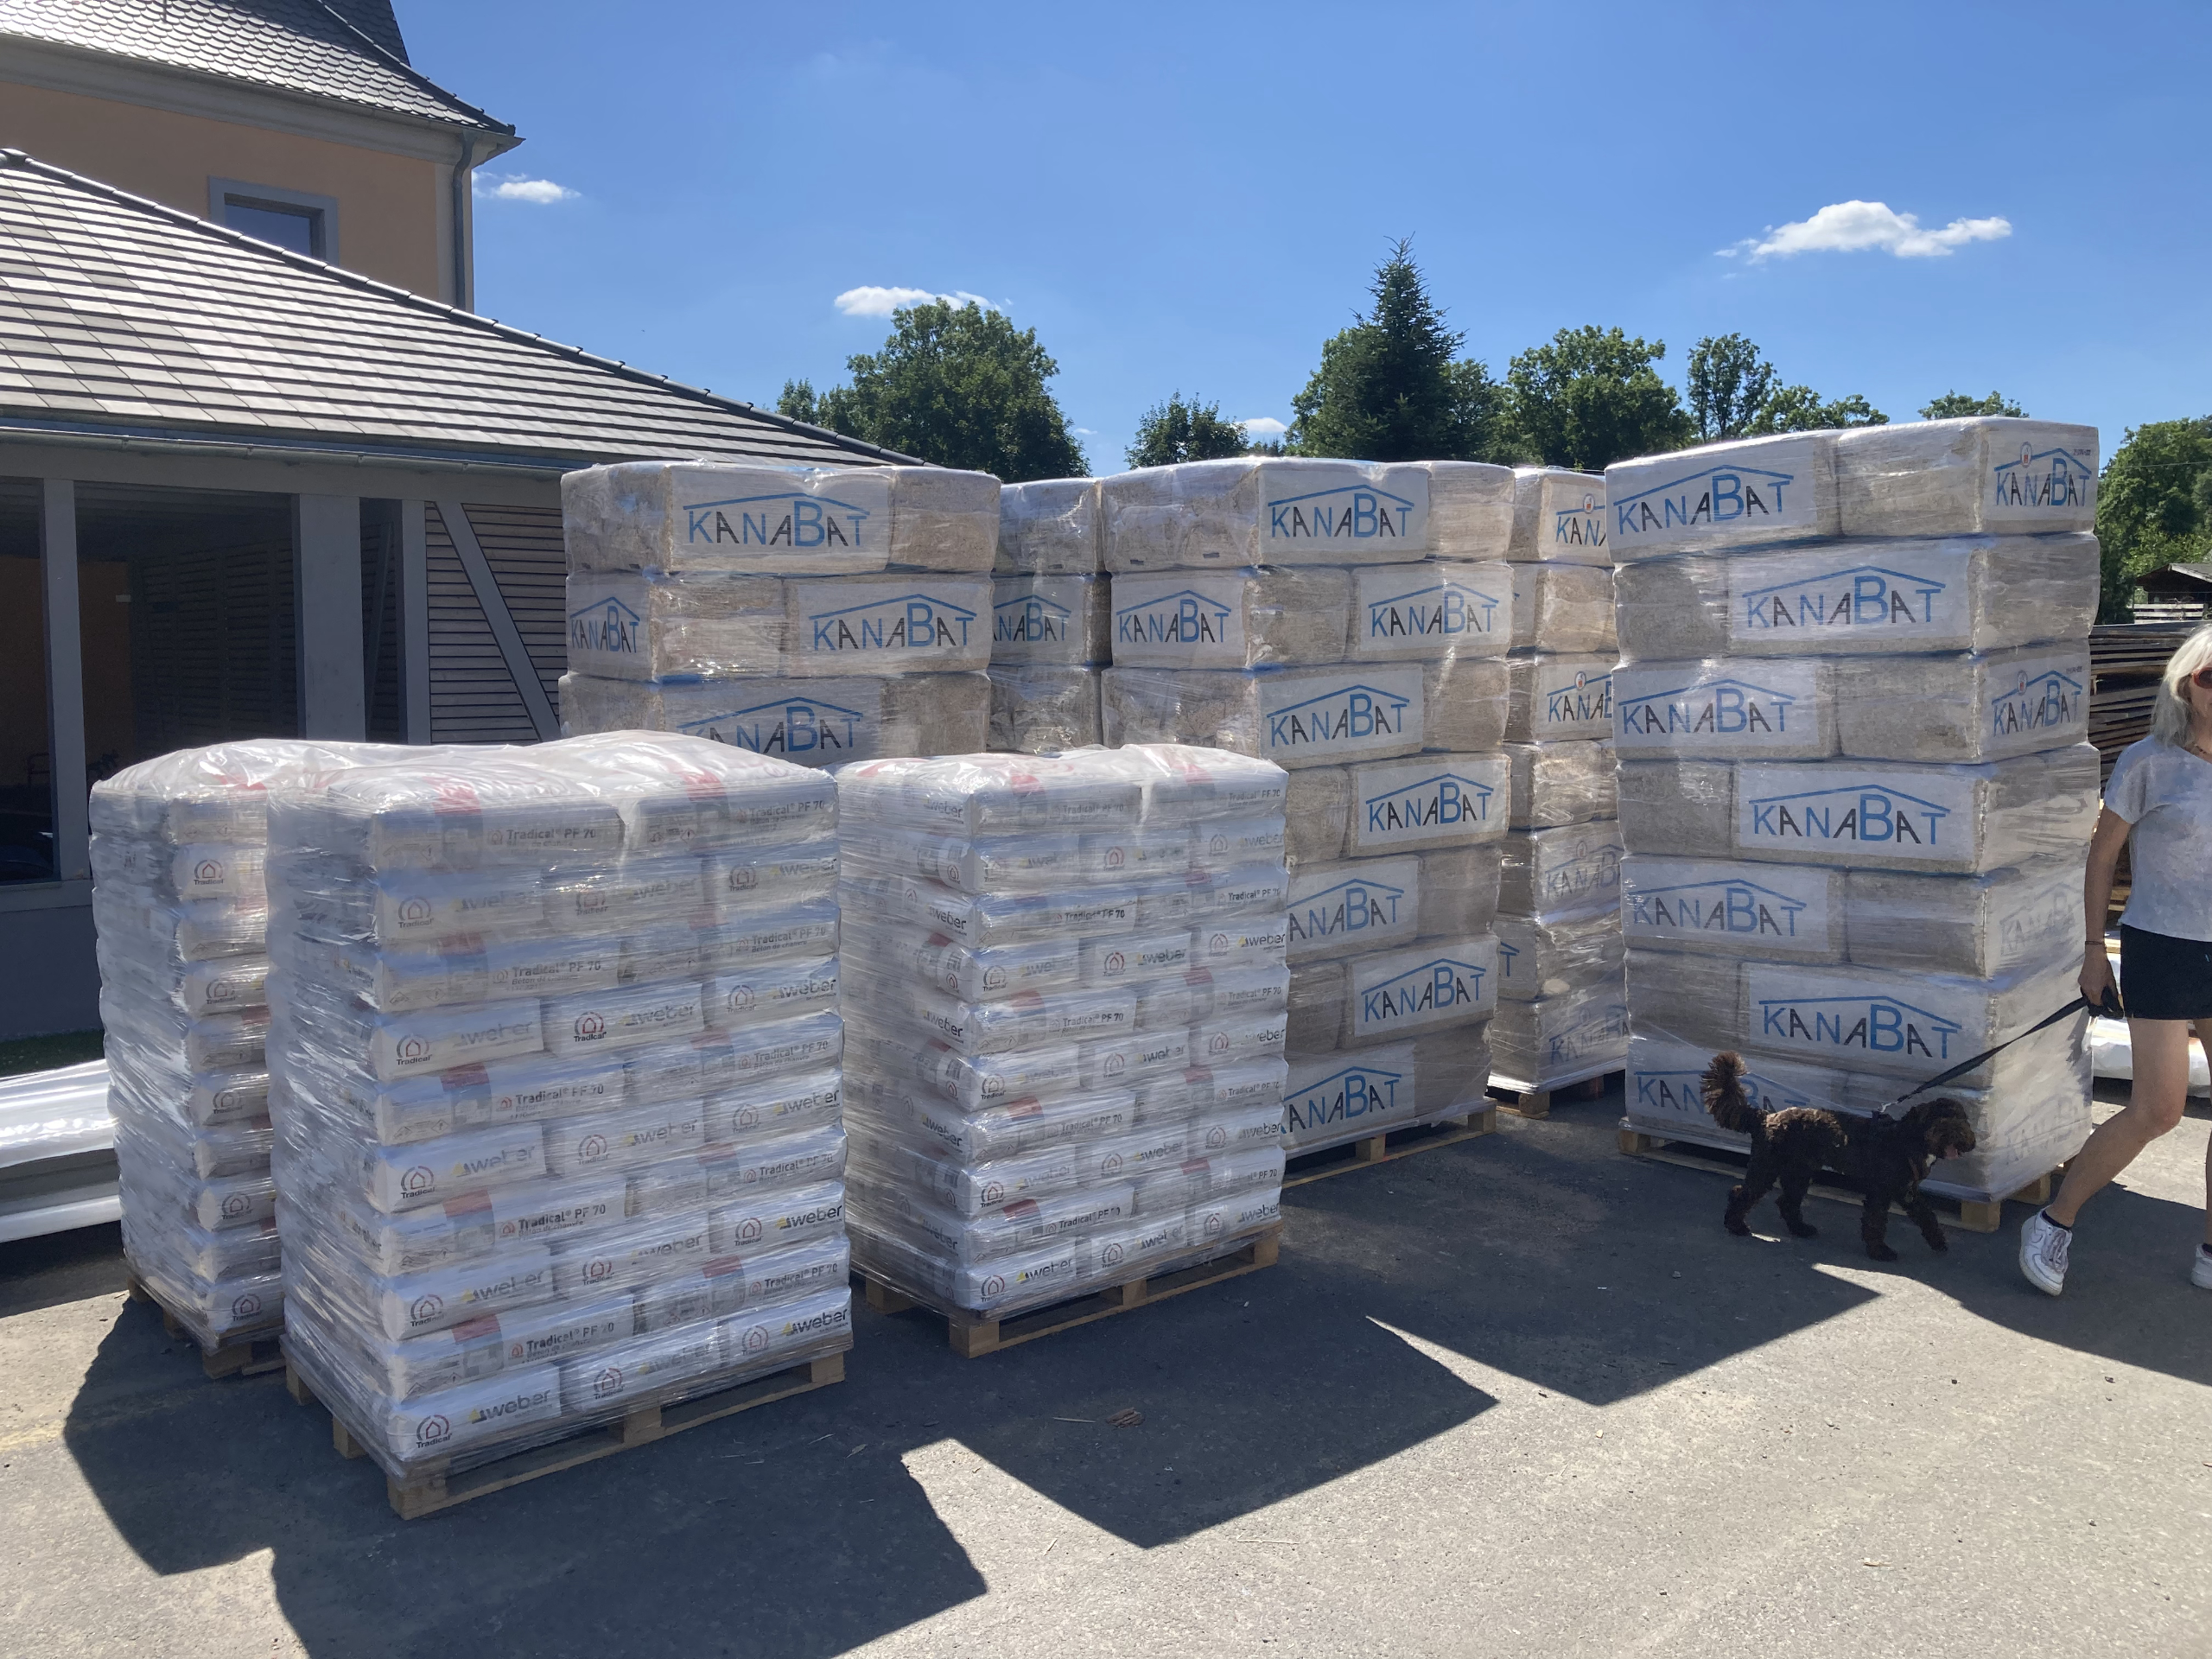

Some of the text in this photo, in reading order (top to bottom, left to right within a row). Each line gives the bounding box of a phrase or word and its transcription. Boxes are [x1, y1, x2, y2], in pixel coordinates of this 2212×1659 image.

[1996, 457, 2090, 507] KANABAT
[1271, 493, 1413, 539] KANABAT
[1618, 474, 1790, 537] KANABAT
[690, 501, 870, 547] KANABAT
[1556, 516, 1606, 547] KAN
[1371, 590, 1497, 638] KANABAT
[1747, 575, 1944, 629] KANABAT
[571, 605, 639, 653] KANABAT
[813, 603, 975, 651] KANABAT
[1119, 599, 1231, 644] KANABAT
[1270, 693, 1409, 748] KANABAT
[1623, 688, 1793, 735] KANABAT
[1993, 679, 2082, 738] KANABAT
[1369, 781, 1492, 833] KANABAT
[1753, 793, 1950, 846] KANABAT
[934, 906, 967, 930] weber
[1632, 887, 1808, 937] KANABAT
[1249, 931, 1286, 946] weber
[784, 978, 836, 998] weber
[1364, 967, 1485, 1023] KANABAT
[638, 1002, 696, 1025] weber
[930, 1012, 963, 1037] weber
[574, 1031, 607, 1043] Tradical
[1764, 1003, 1961, 1059] KANABAT
[396, 1054, 433, 1065] Tradical
[787, 1089, 841, 1114] weber
[981, 1090, 1007, 1100] Tradical
[1281, 1074, 1402, 1135] ANABAT
[1246, 1122, 1281, 1139] weber
[401, 1186, 435, 1198] Tradical
[791, 1205, 842, 1229] weber
[1244, 1202, 1279, 1222] weber
[734, 1235, 764, 1247] Tradical
[1028, 1258, 1072, 1281] weber
[795, 1308, 848, 1333] weber
[486, 1389, 551, 1419] weber
[416, 1433, 454, 1449] Tradical
